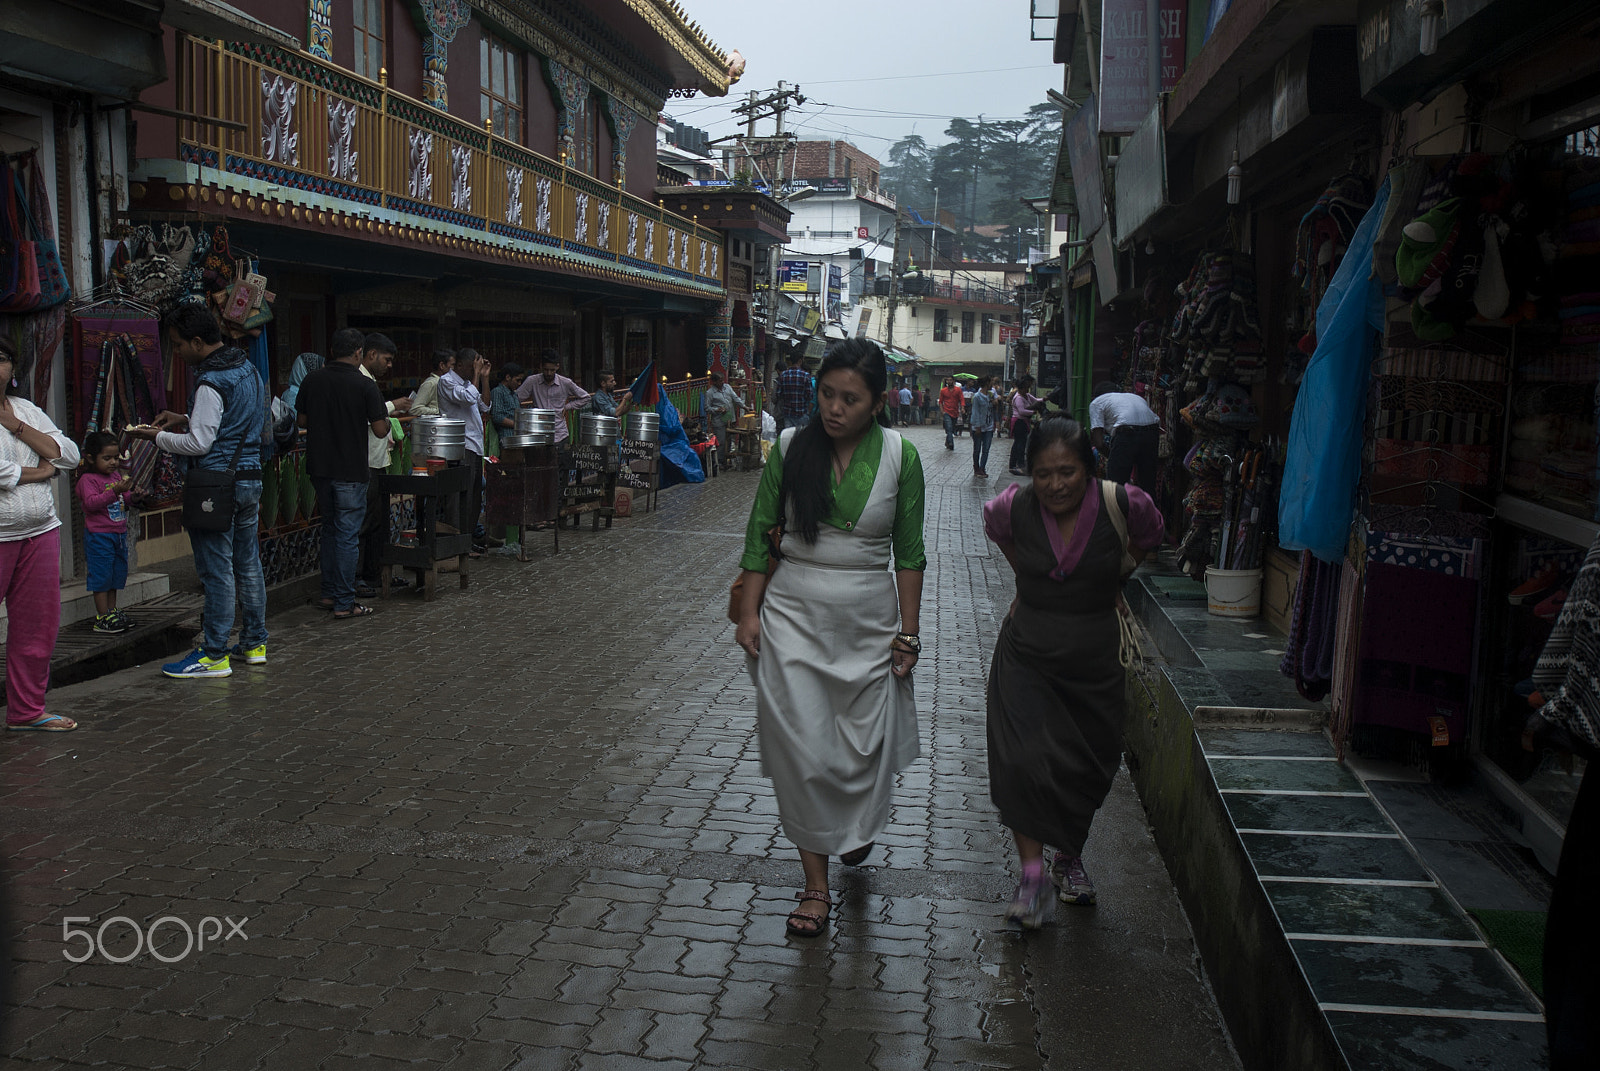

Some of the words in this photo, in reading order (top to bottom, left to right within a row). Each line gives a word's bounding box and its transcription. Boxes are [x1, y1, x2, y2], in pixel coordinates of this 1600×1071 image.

[1106, 9, 1182, 39] KAILSH
[1115, 46, 1173, 59] HOTL
[1107, 65, 1178, 79] RESTAUNT
